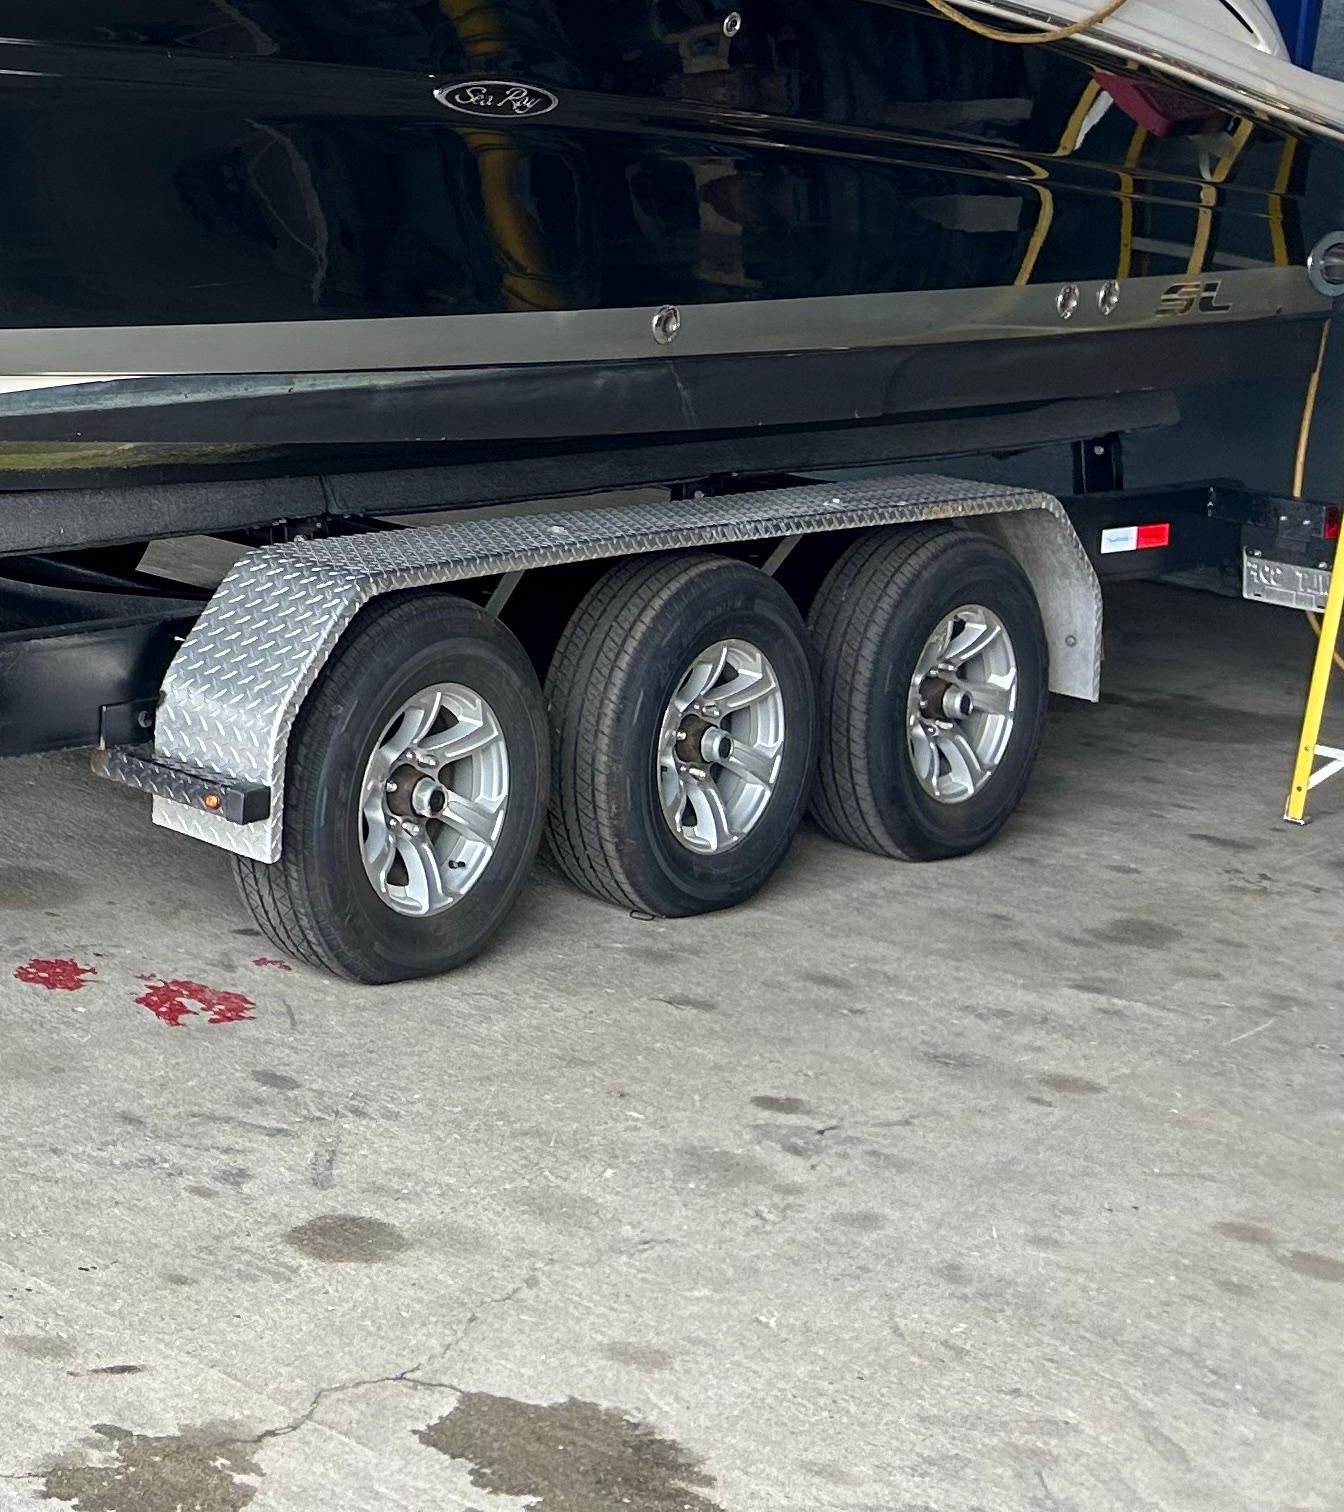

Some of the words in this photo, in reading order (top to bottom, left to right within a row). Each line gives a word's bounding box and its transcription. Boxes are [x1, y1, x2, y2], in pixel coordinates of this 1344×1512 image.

[454, 86, 493, 107] Sea
[497, 86, 542, 114] Ray
[1155, 281, 1233, 317] SL
